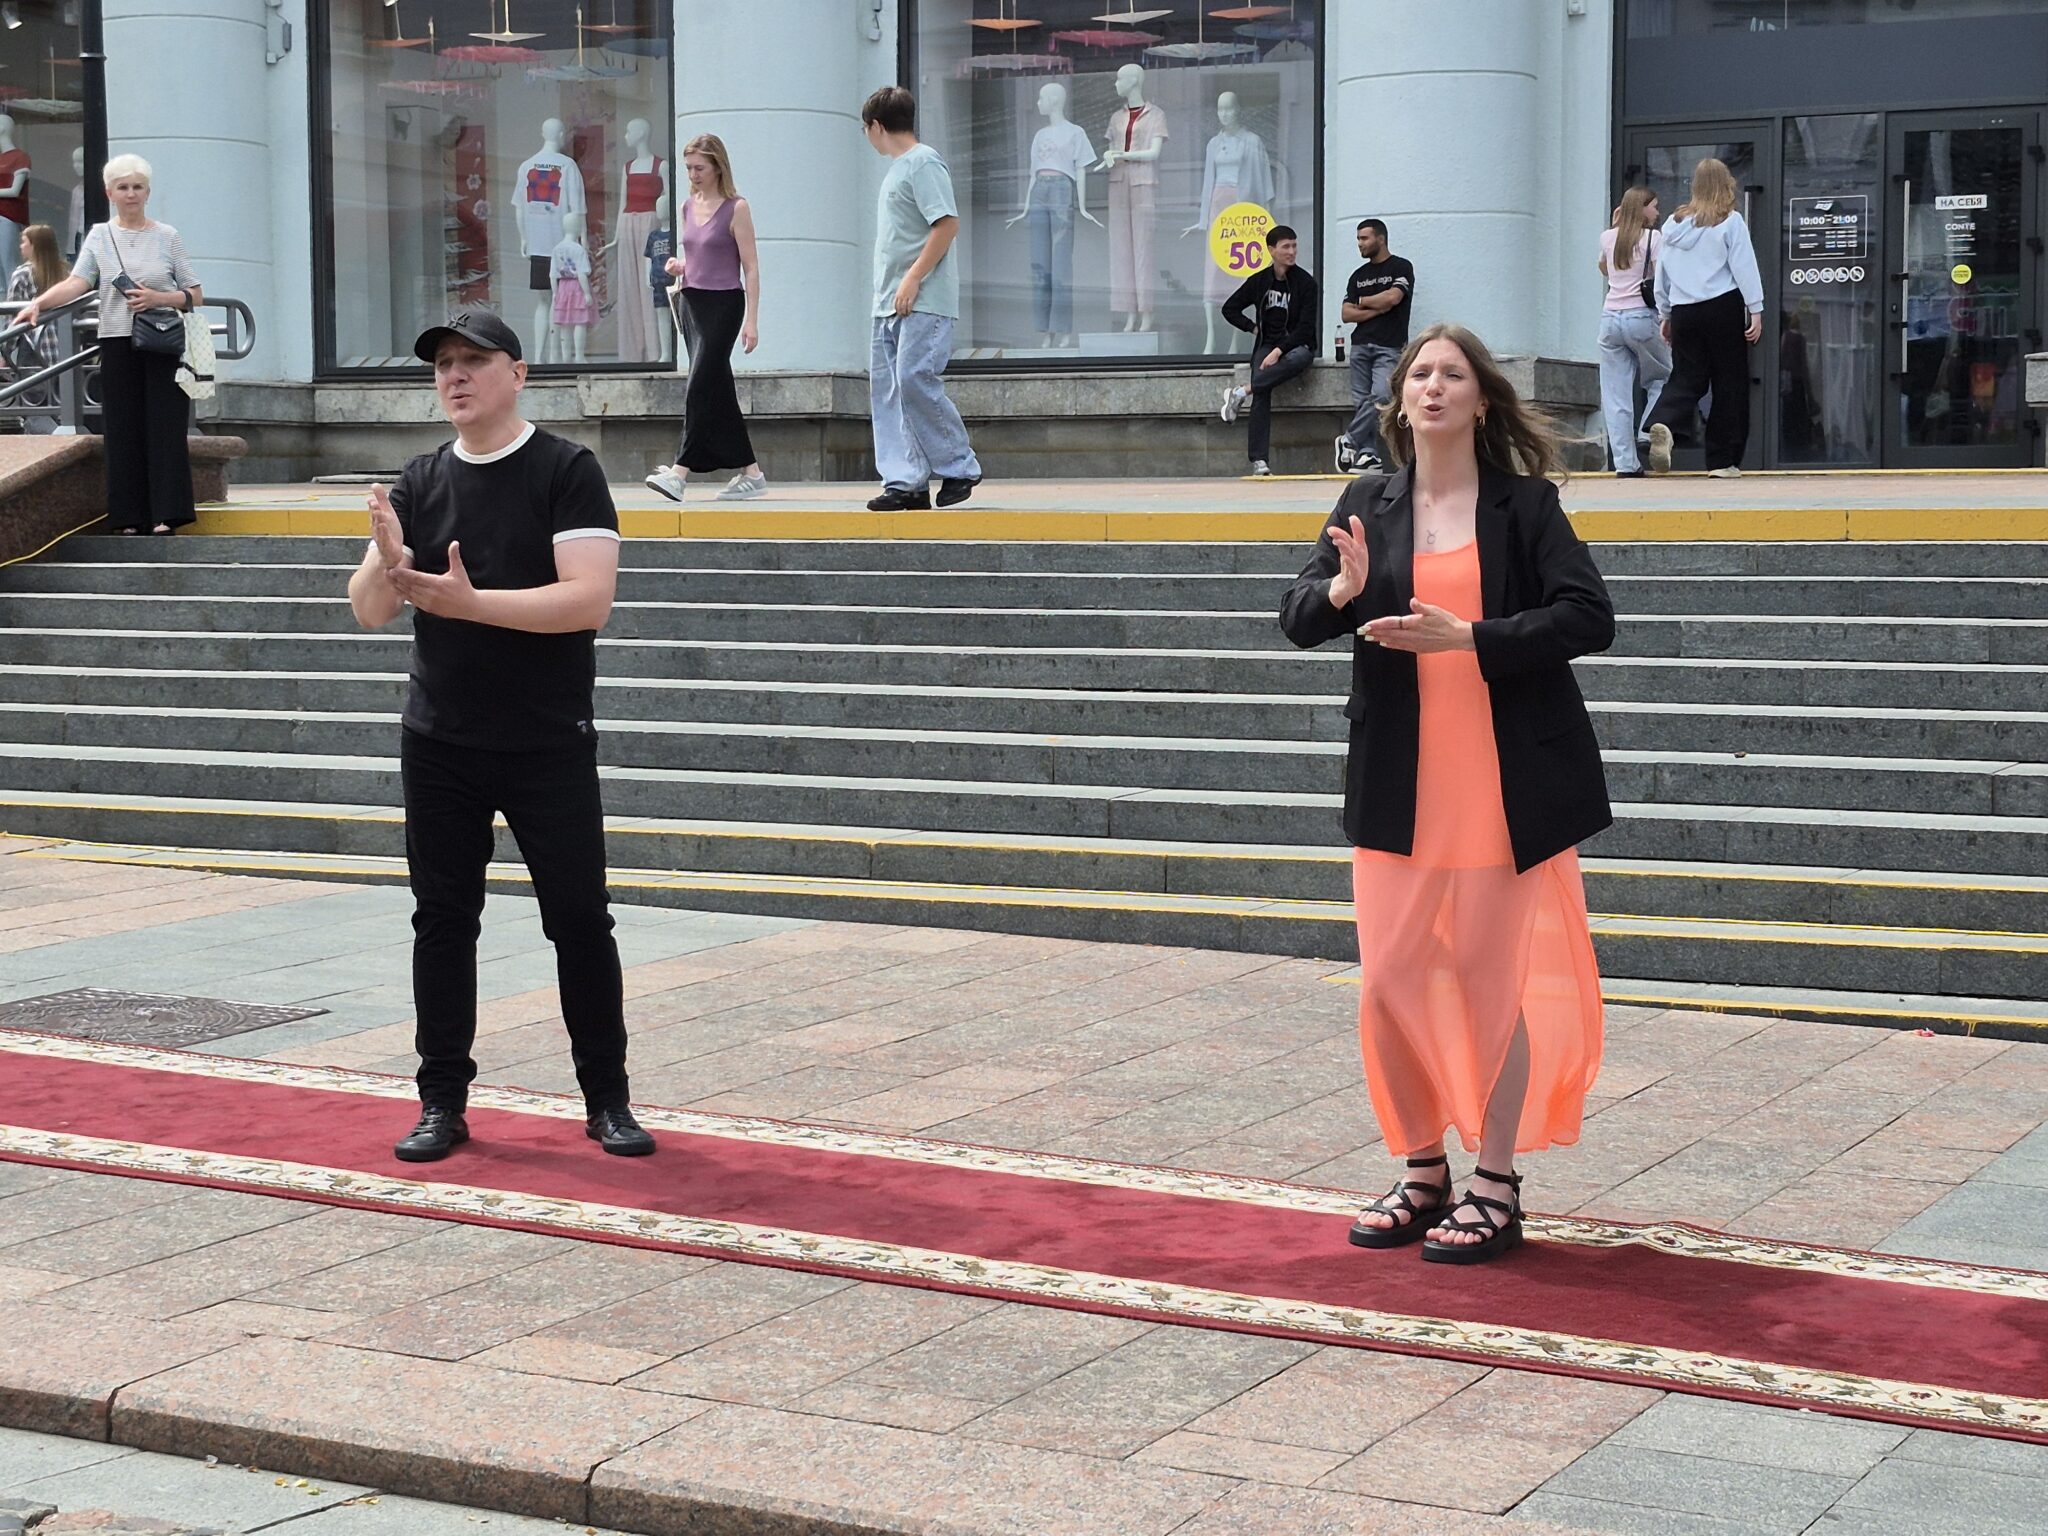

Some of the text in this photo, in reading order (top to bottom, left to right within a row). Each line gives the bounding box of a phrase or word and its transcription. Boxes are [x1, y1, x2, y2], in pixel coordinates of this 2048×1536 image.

[1941, 199, 1955, 207] НА
[1220, 215, 1268, 226] РАСПРО
[1945, 223, 1976, 231] CONTE
